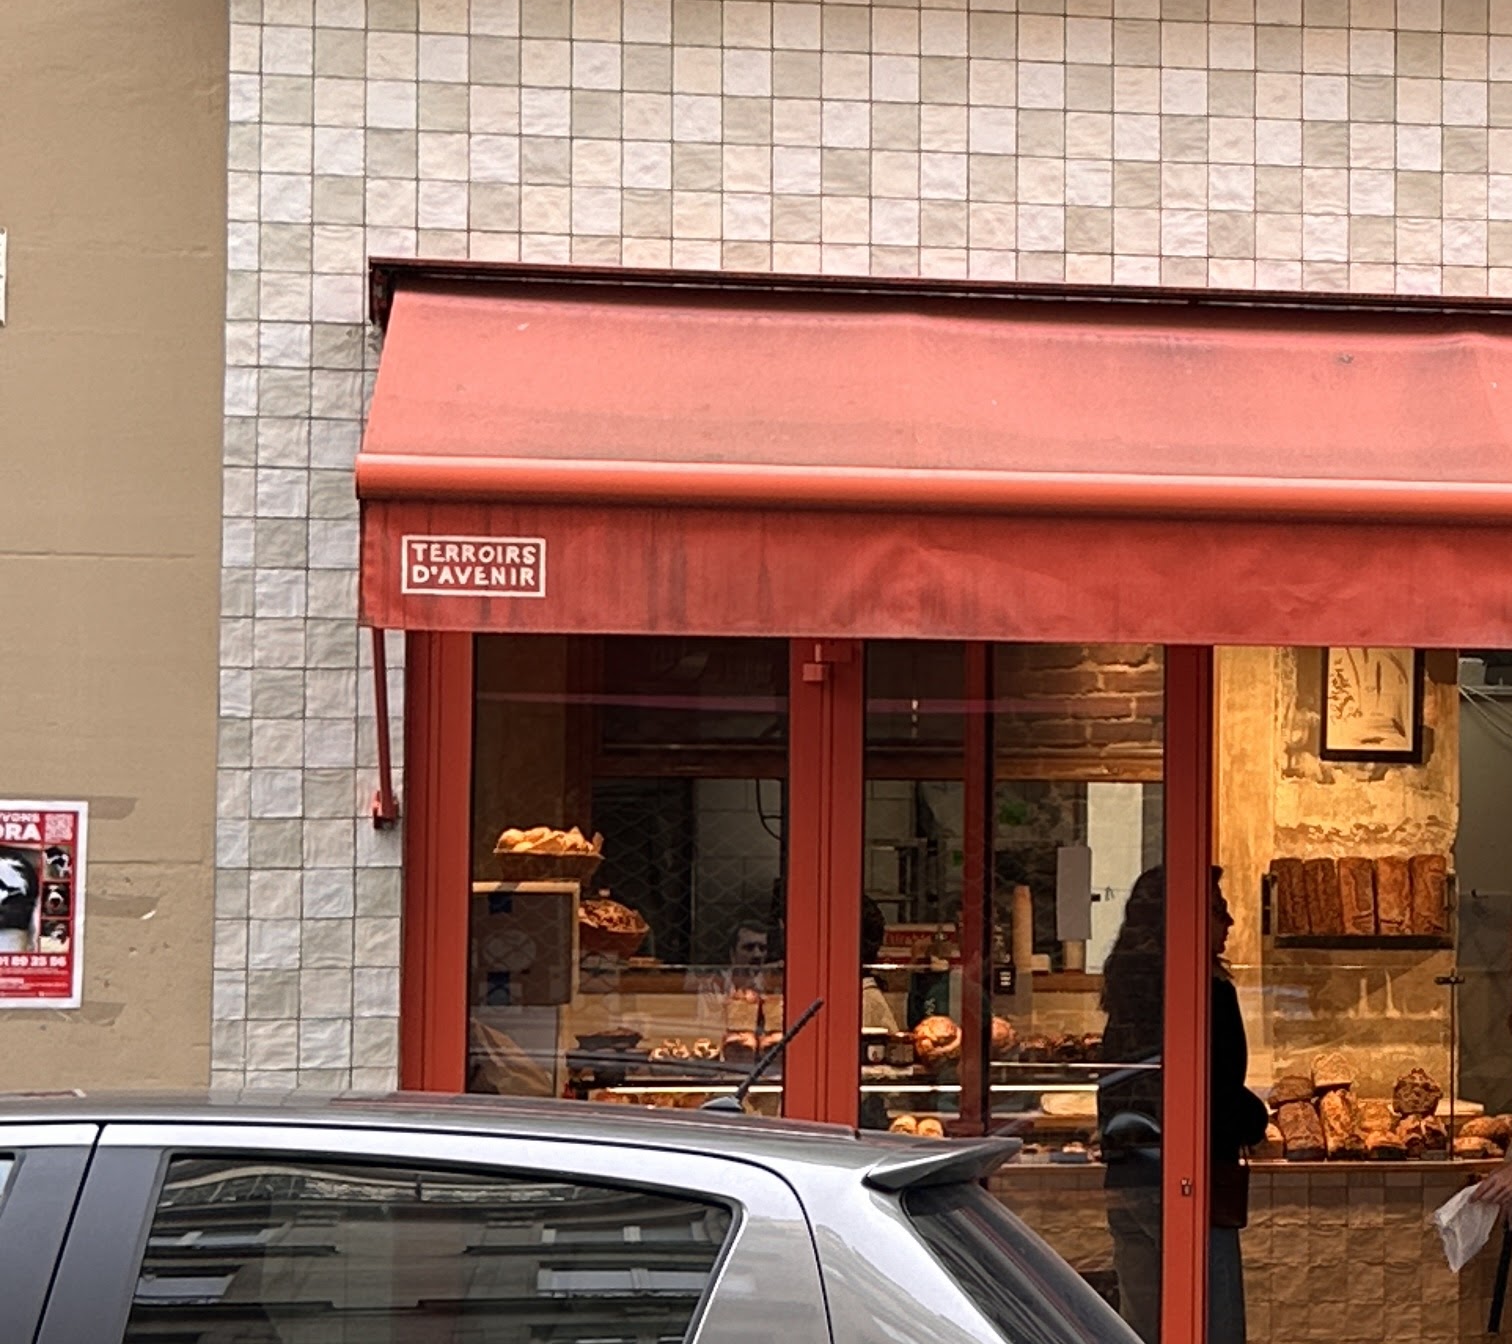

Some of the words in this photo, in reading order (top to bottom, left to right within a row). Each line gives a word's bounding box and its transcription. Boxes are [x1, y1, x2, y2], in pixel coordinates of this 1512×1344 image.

[411, 543, 537, 564] TERROIRS
[412, 566, 535, 587] D'AVENIR
[0, 822, 41, 841] RA
